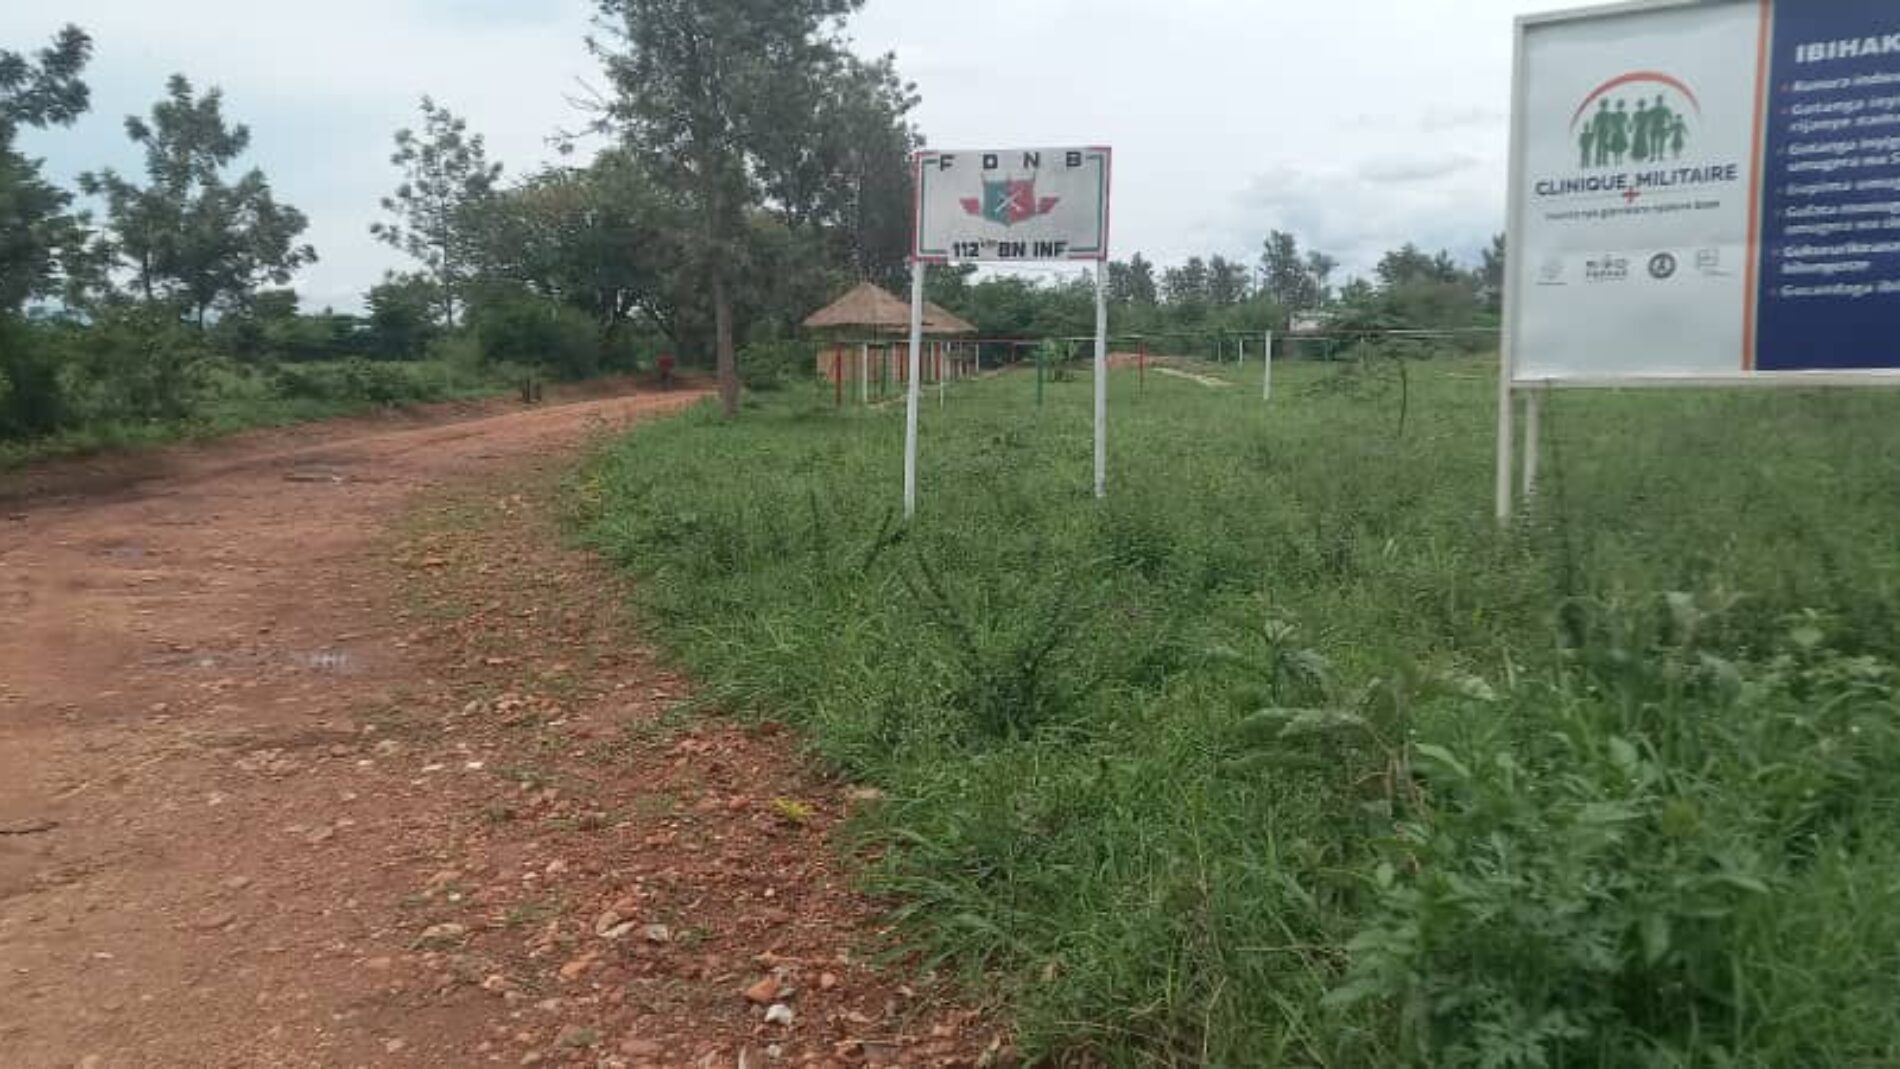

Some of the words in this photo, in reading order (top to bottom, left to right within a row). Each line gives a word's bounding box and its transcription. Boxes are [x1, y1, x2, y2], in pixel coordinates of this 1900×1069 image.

[1795, 33, 1900, 63] IBIHAK
[1535, 174, 1627, 195] CLINIQUE
[1636, 164, 1738, 187] MILITAIRE
[998, 242, 1026, 257] BN
[1033, 242, 1067, 257] INF
